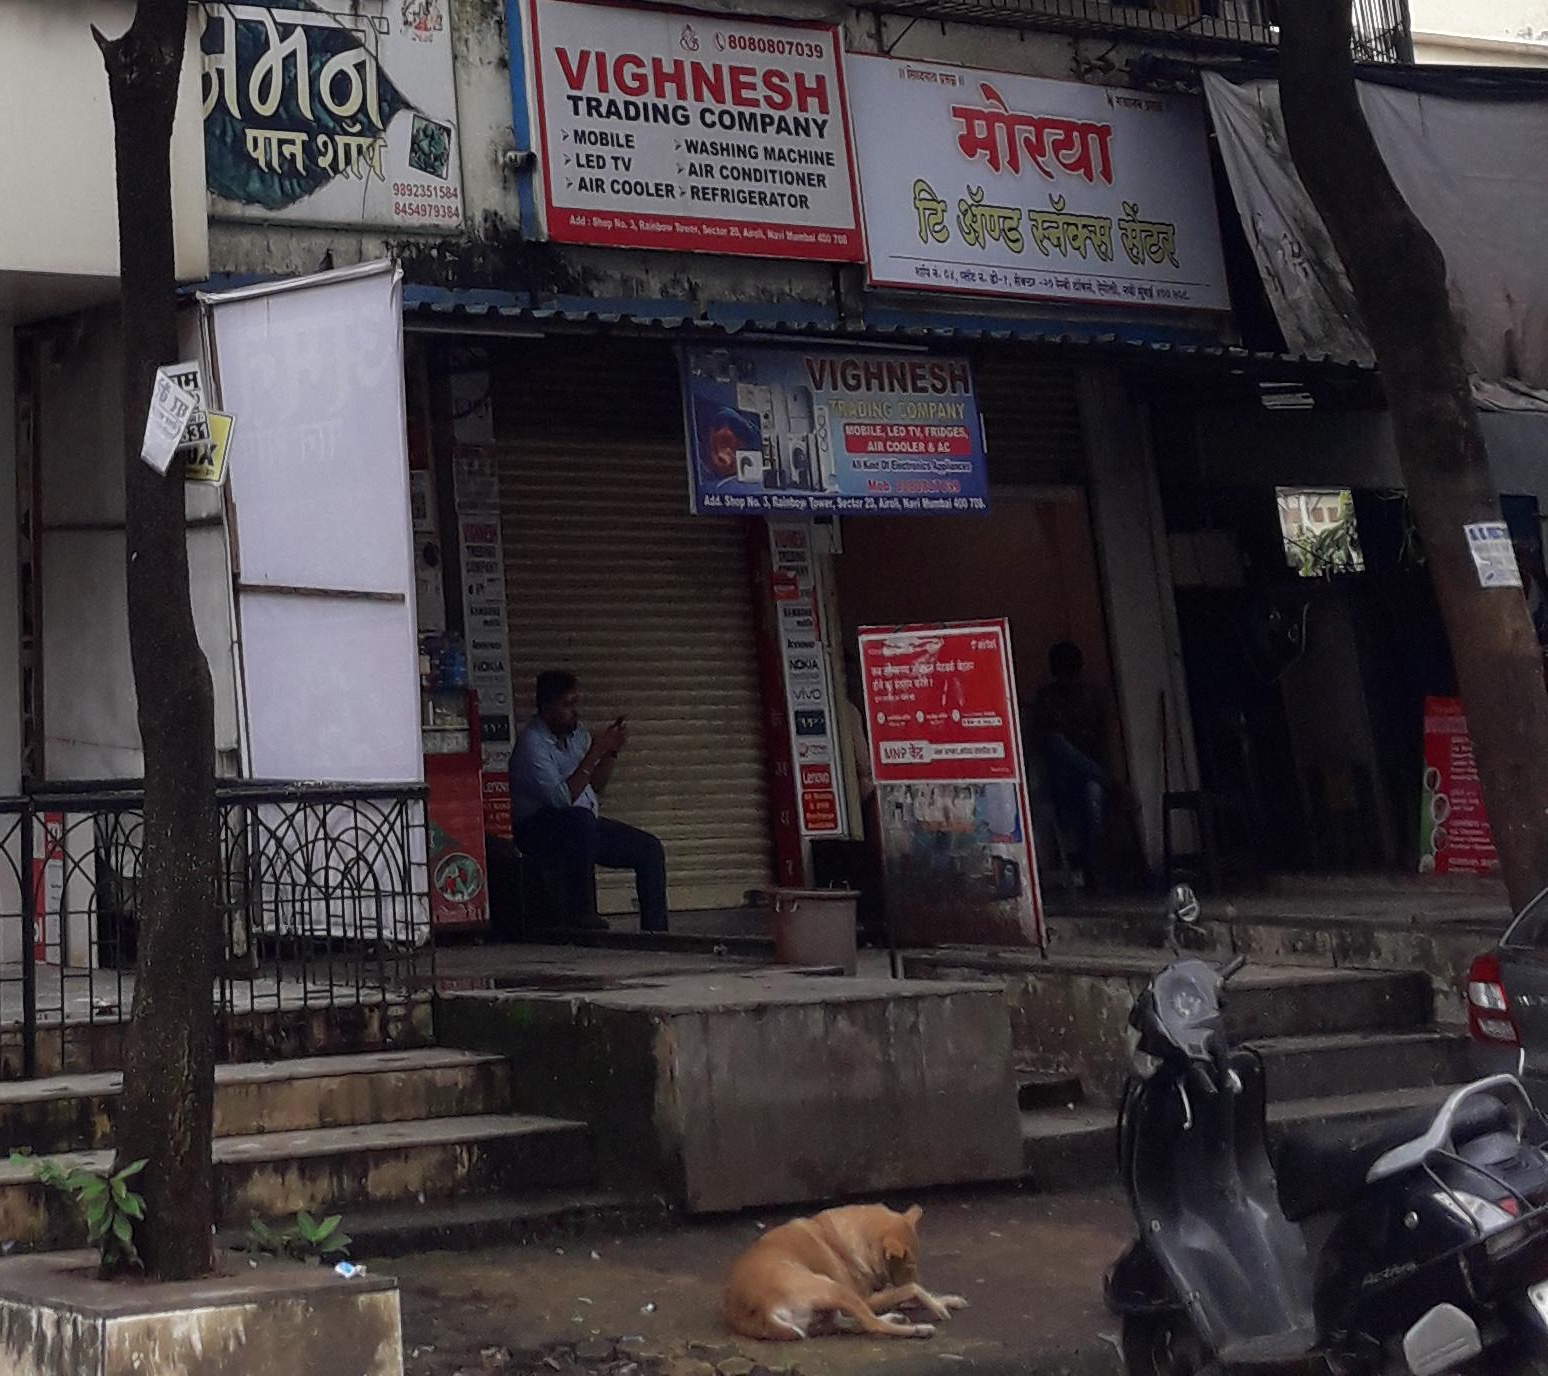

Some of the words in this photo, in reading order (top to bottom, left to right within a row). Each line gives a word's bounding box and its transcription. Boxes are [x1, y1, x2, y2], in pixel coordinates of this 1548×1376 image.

[727, 34, 824, 58] 8080807039
[554, 47, 830, 115] VIGHNESH
[566, 95, 691, 126] TRADING
[699, 107, 829, 139] COMPANY
[574, 129, 635, 149] MOBILE
[951, 82, 1115, 187] मोरया
[245, 129, 309, 176] पान
[316, 121, 388, 182] शॉप
[576, 153, 606, 171] LED
[611, 155, 632, 172] TV
[684, 139, 759, 160] WASHING
[764, 147, 835, 167] MACHINE
[578, 176, 606, 194] AIR
[610, 179, 675, 199] COOLER
[688, 163, 714, 180] AIR
[719, 164, 827, 189] CONDITIONER
[690, 185, 810, 210] REFRIGERATOR
[913, 178, 950, 245] टि
[805, 357, 970, 395] VIGHNESH
[828, 399, 892, 419] TRADING
[901, 400, 965, 420] COMPANY
[887, 425, 906, 437] LED
[867, 441, 884, 452] AIR
[886, 441, 926, 453] COOLER
[937, 442, 951, 453] AC
[725, 495, 745, 510] Shop
[747, 496, 761, 508] No.
[473, 660, 505, 673] NOKIA
[789, 659, 819, 671] NOKIA
